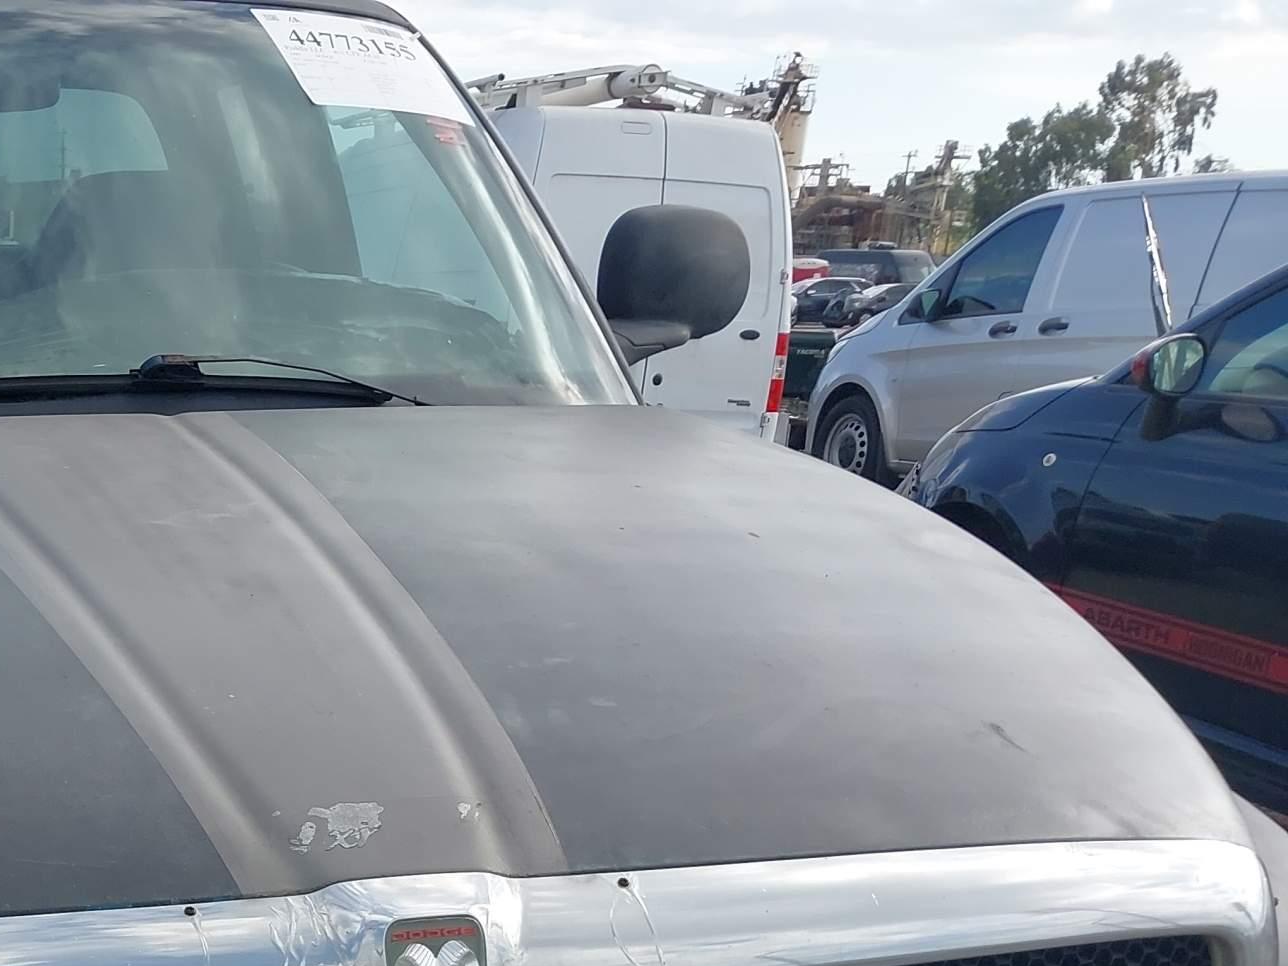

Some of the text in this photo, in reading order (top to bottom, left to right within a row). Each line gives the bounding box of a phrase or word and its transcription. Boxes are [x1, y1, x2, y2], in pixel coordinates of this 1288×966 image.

[289, 29, 417, 61] 44773155
[1083, 607, 1169, 645] ABARTH
[392, 927, 477, 941] DODGE
